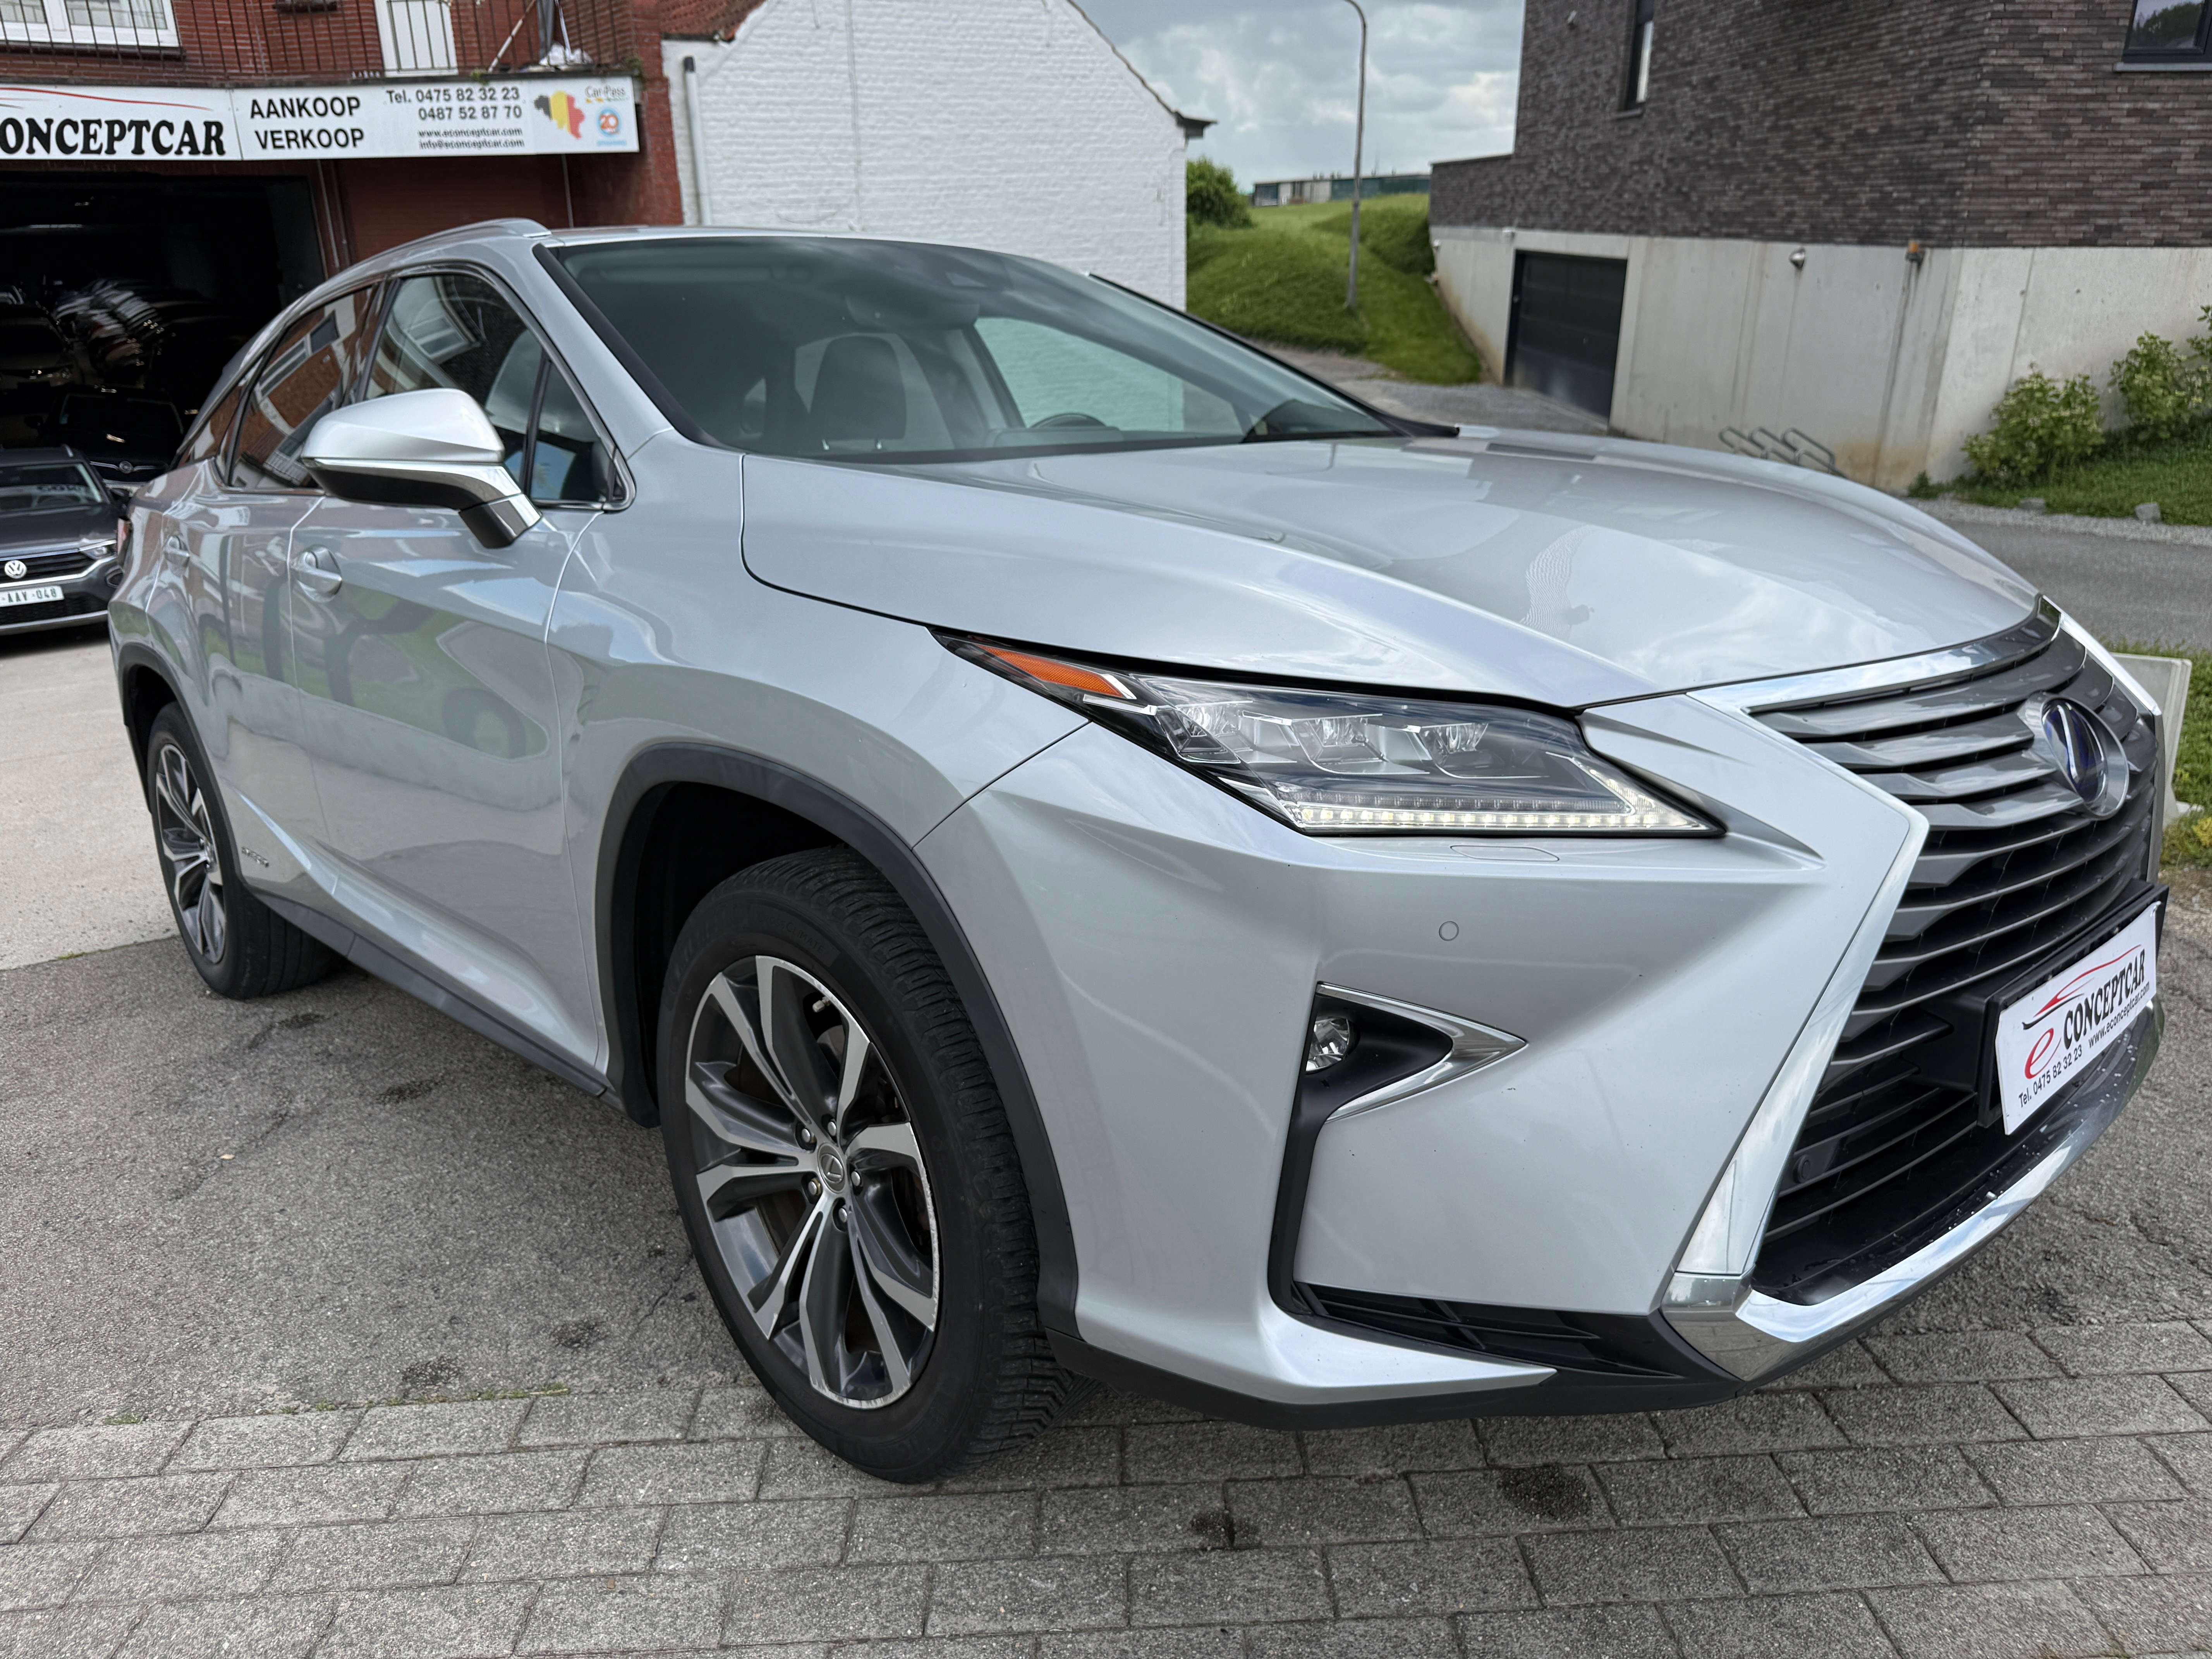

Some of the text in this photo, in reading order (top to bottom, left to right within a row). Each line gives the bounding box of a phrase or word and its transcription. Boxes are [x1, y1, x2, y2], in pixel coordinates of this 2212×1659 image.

[386, 86, 520, 103] Tel. 0475 82 32 23
[250, 96, 361, 119] AANKOOP
[418, 105, 522, 120] 0487 52 87 70
[254, 128, 364, 149] VERKOOP
[418, 128, 522, 137] www.econceptcar.com
[419, 138, 525, 149] info@econceptcar.com
[2064, 948, 2145, 1050] CONCEPTCAR
[2018, 981, 2150, 1108] Tel. 0475 82 32 23 www.econceptcar.com
